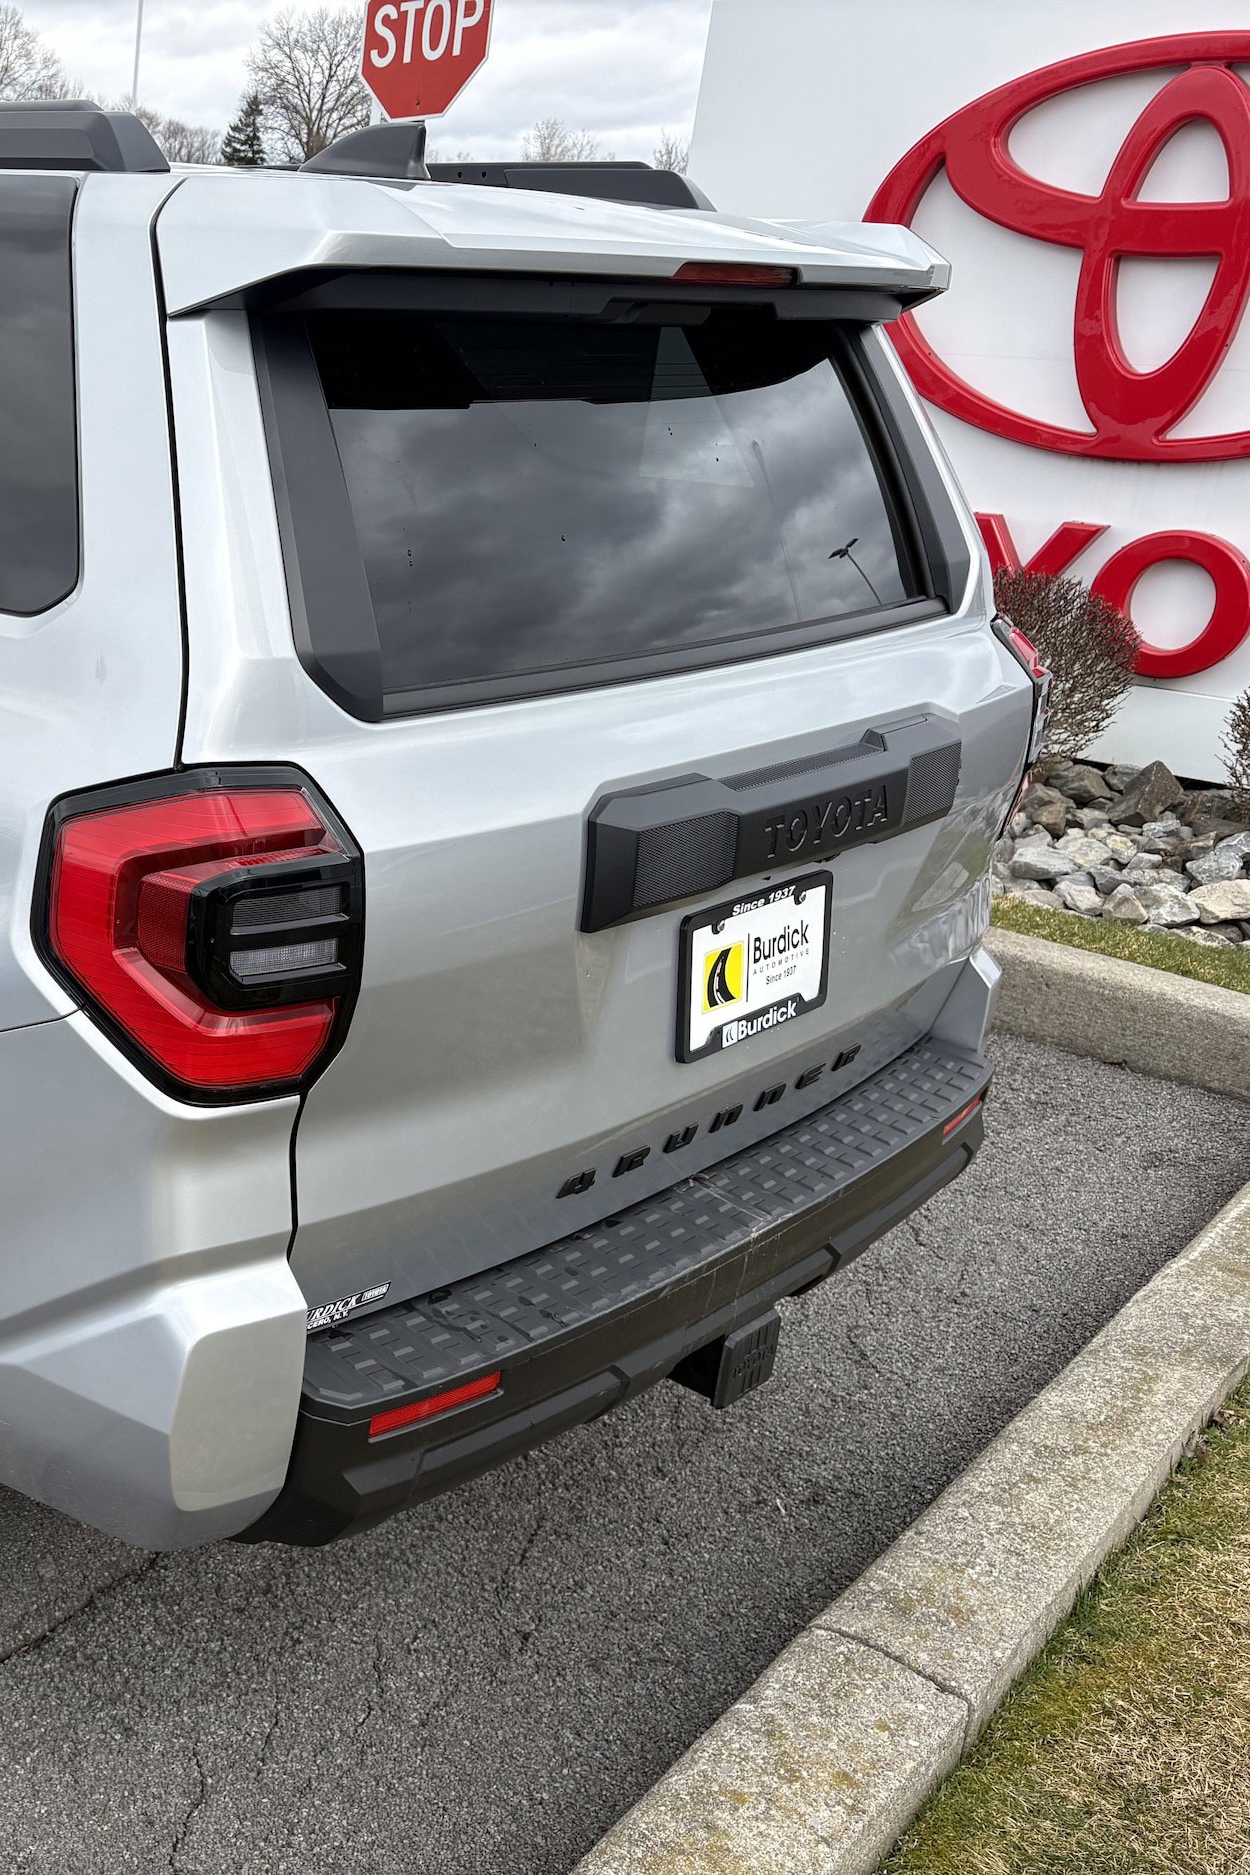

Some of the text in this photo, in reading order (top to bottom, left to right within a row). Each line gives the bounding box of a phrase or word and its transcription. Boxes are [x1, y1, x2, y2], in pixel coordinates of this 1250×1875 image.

[370, 0, 485, 68] STOP
[764, 784, 888, 859] TOYOTA
[732, 885, 796, 916] Since 1937
[752, 947, 810, 977] AUTOMOTIVE
[753, 919, 809, 964] Burdick
[765, 964, 797, 986] Since 1937
[737, 1001, 798, 1041] Burdick
[555, 1042, 862, 1200] 4RUNNER
